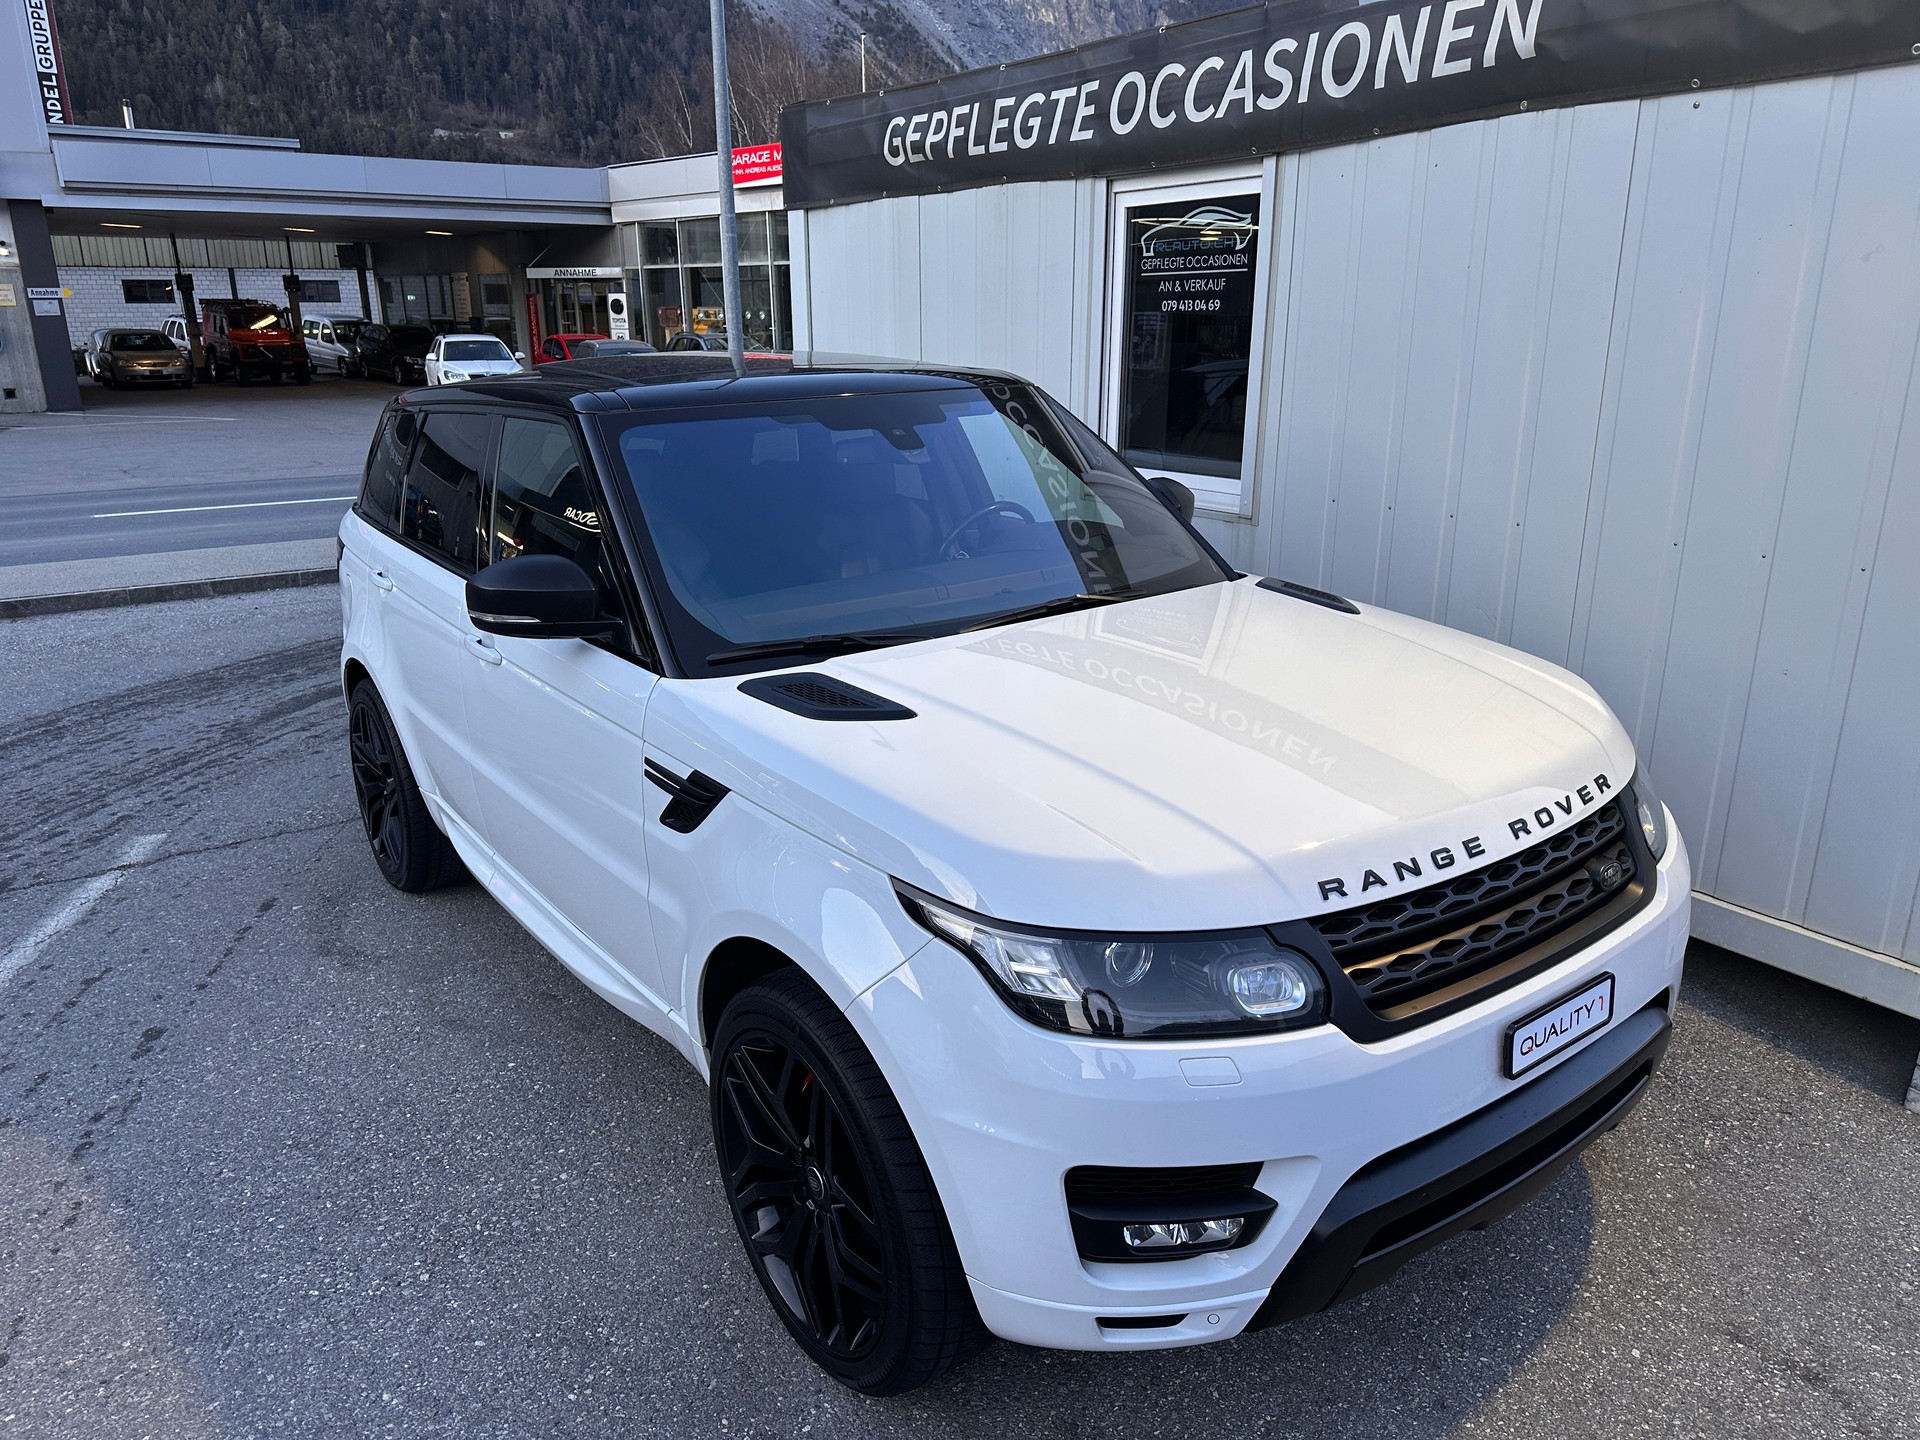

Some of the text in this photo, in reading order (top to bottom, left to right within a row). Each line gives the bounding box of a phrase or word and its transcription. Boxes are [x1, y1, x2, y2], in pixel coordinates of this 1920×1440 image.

[29, 0, 54, 69] GRUPPE
[883, 0, 1543, 167] GEPFLEGTE OCCASIONEN
[1140, 253, 1249, 271] GEPFLEGTE OCCASIONEN
[553, 269, 598, 277] ANNAHME
[30, 289, 59, 297] Annahme
[1158, 278, 1227, 293] AN & VERKAUF
[1161, 299, 1221, 312] 079 413 04 69
[1317, 773, 1612, 900] RANGE ROVER
[1519, 999, 1596, 1056] QUALITY
